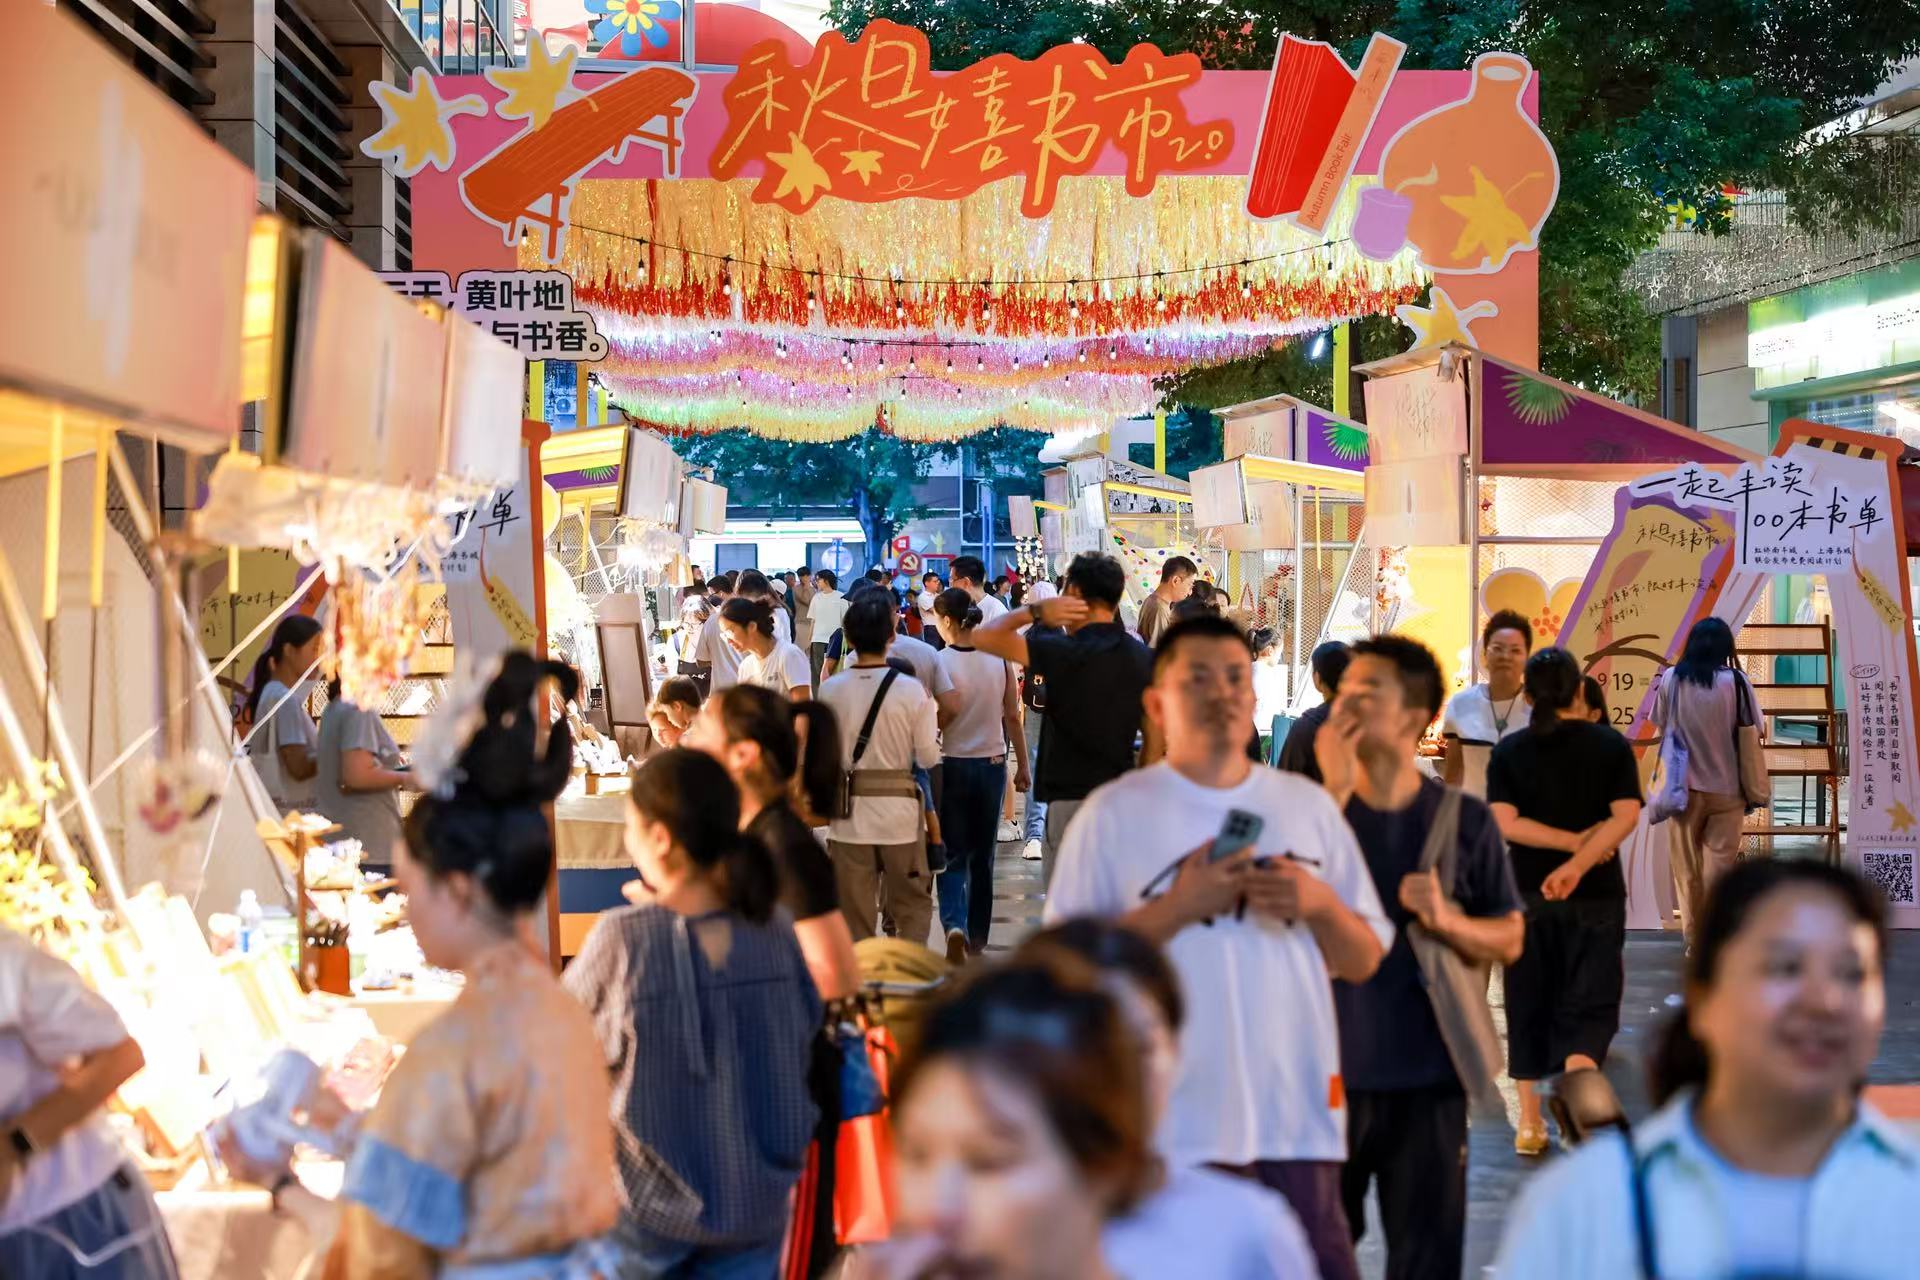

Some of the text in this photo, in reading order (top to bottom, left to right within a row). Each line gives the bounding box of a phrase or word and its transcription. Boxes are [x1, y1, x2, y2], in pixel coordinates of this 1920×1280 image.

[1306, 133, 1352, 223] Autumn Book Fair
[1598, 673, 1607, 687] 9
[1613, 673, 1634, 691] 19
[1613, 707, 1634, 725] 25
